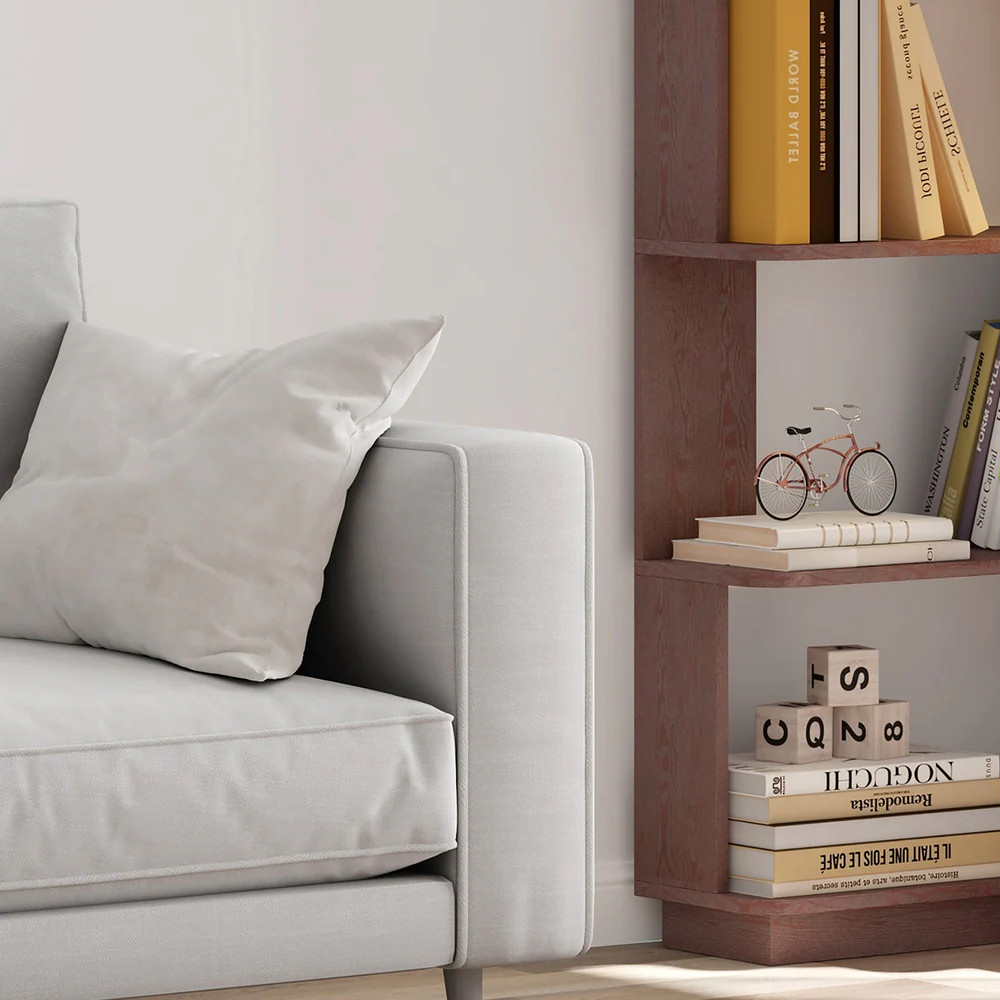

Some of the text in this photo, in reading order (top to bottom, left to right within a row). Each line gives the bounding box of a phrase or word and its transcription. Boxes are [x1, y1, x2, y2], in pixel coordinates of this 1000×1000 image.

[953, 356, 967, 391] Columbia
[976, 359, 1000, 452] FORM STYLE
[924, 426, 951, 513] WASHINGTON
[976, 448, 998, 529] State Capital
[811, 663, 869, 691] T S
[762, 716, 904, 750] C Q 2 8
[824, 761, 955, 792] NOGUCHI
[850, 793, 933, 812] Remodelista
[820, 843, 952, 874] IL ÉTAIT UNE FOIS LE CAFÉ
[811, 881, 839, 891] secrets
[840, 878, 862, 888] petits
[863, 878, 871, 886] et
[888, 873, 927, 884] botanique,
[928, 870, 959, 880] Histoire,
